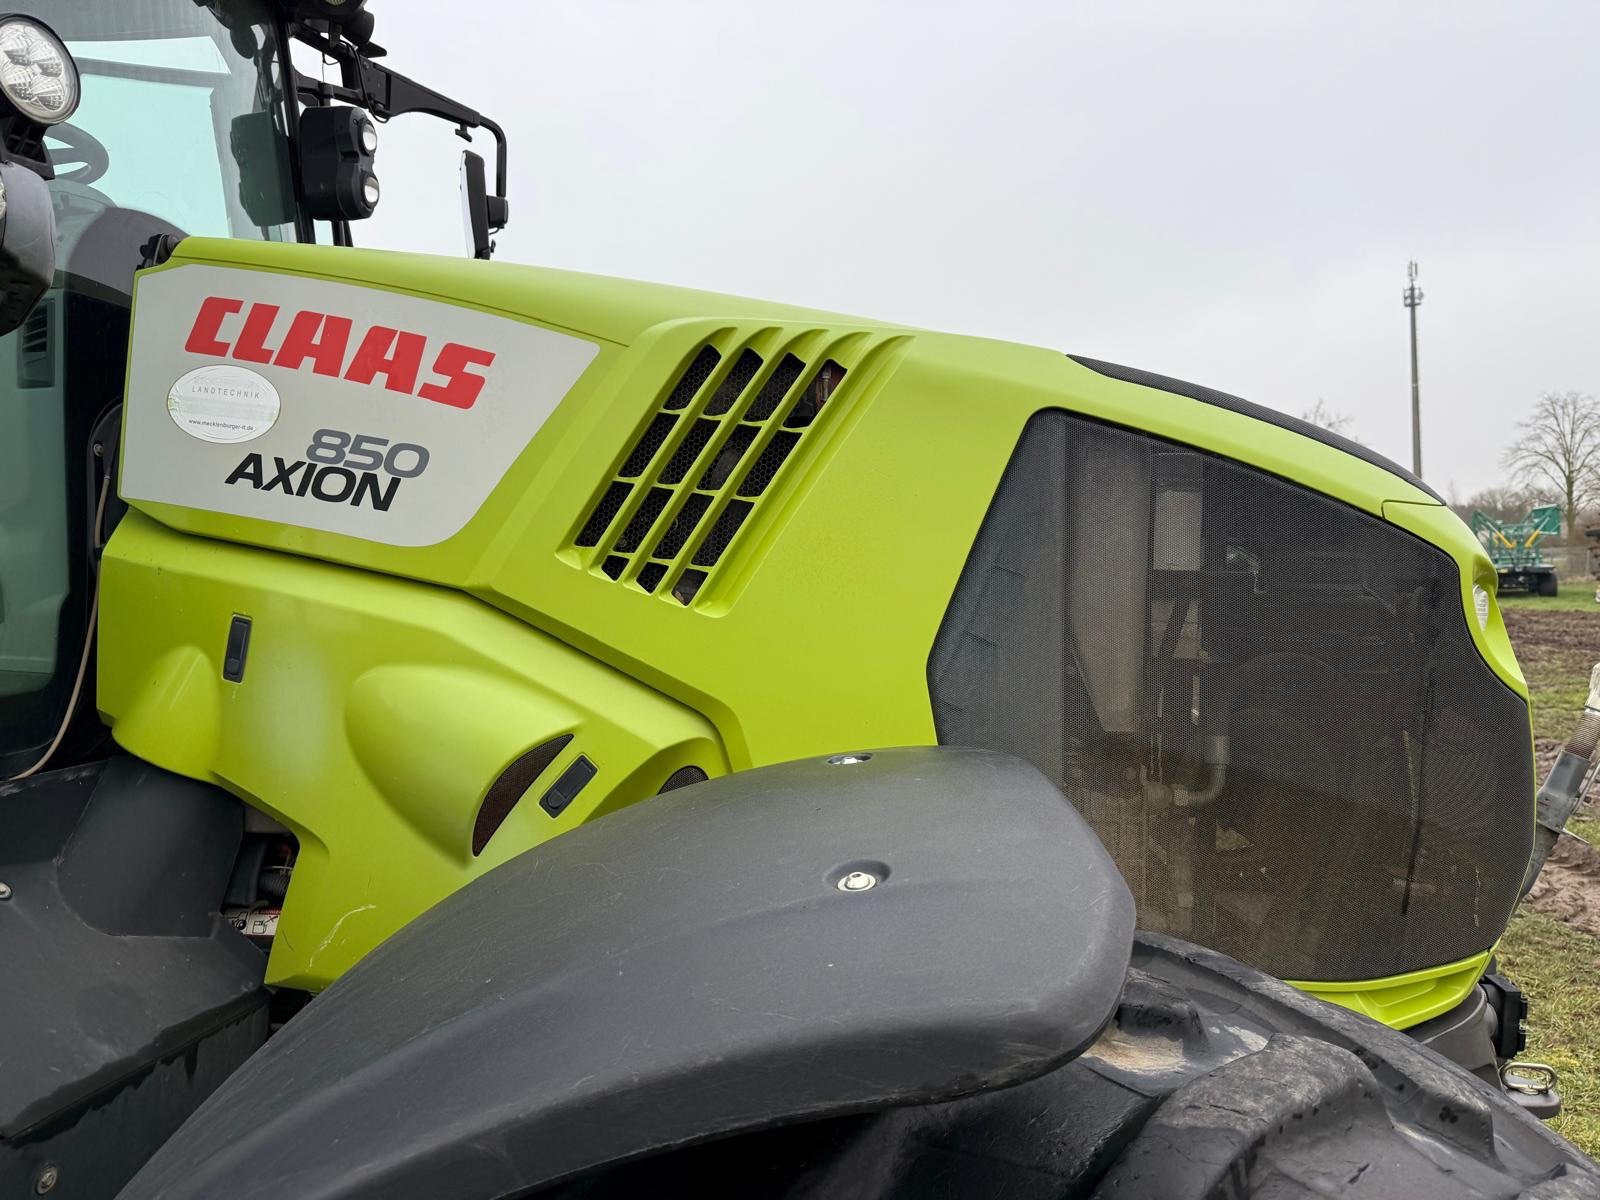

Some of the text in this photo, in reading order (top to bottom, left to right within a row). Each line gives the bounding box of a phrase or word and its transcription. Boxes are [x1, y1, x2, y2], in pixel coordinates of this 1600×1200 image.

[185, 296, 496, 410] CLAAS
[191, 385, 260, 399] LANDTECHNIK
[305, 428, 430, 479] 850
[224, 452, 402, 513] AXION
